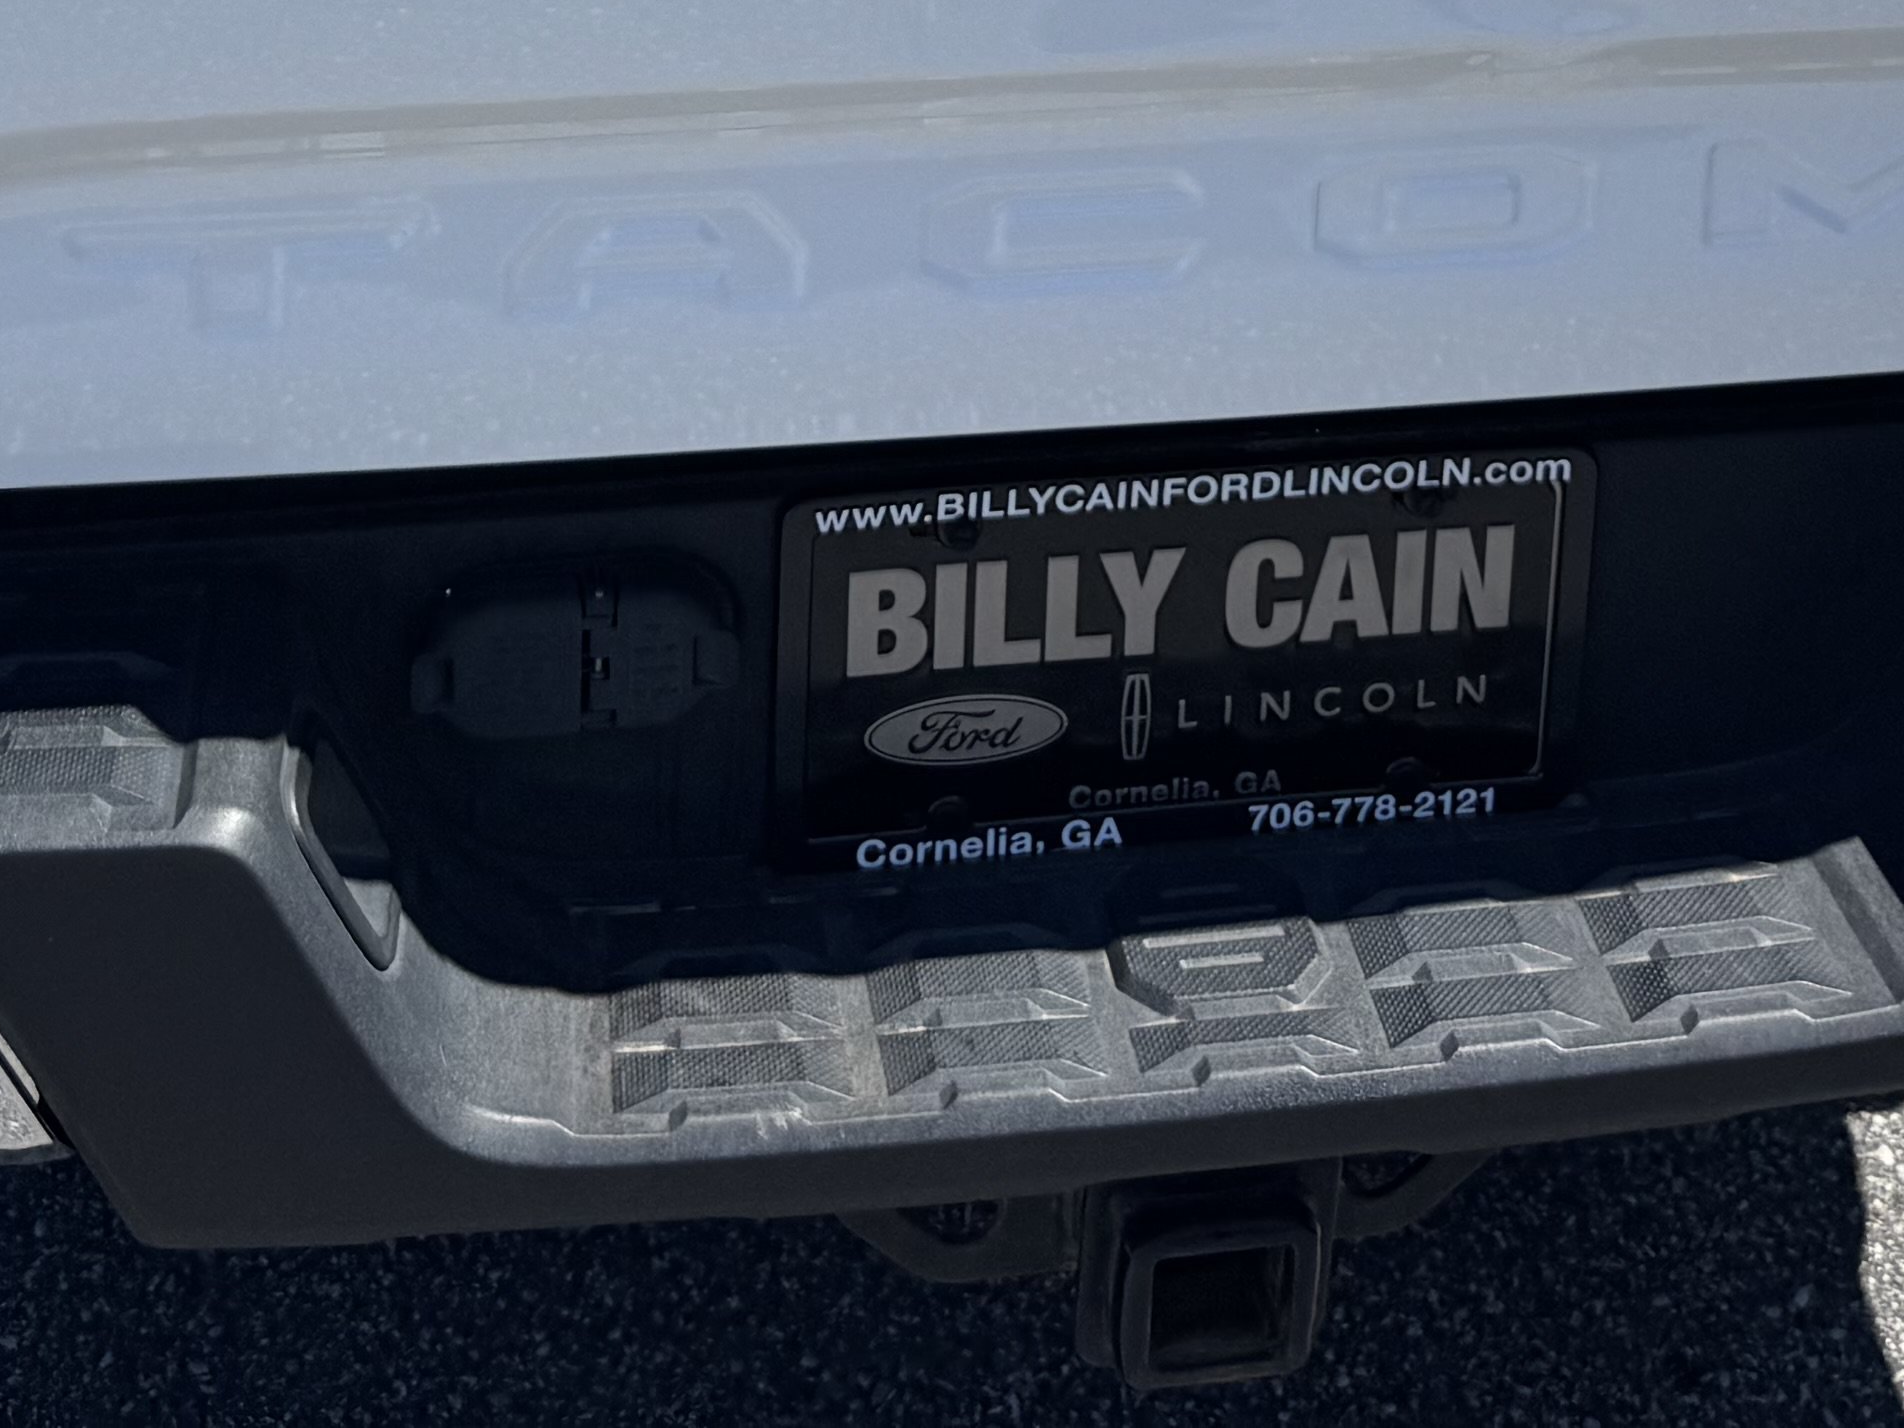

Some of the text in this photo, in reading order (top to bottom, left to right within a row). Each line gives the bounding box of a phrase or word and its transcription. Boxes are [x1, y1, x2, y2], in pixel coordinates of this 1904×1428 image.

[815, 456, 1573, 535] www.BILLYCAINFORDLINCOLN.com
[845, 524, 1516, 678] BILLY CAIN
[1177, 673, 1488, 729] LINCOLN
[855, 785, 1496, 870] Cornelia, GA 706-778-2121
[1068, 769, 1283, 810] Cornelia, GA
